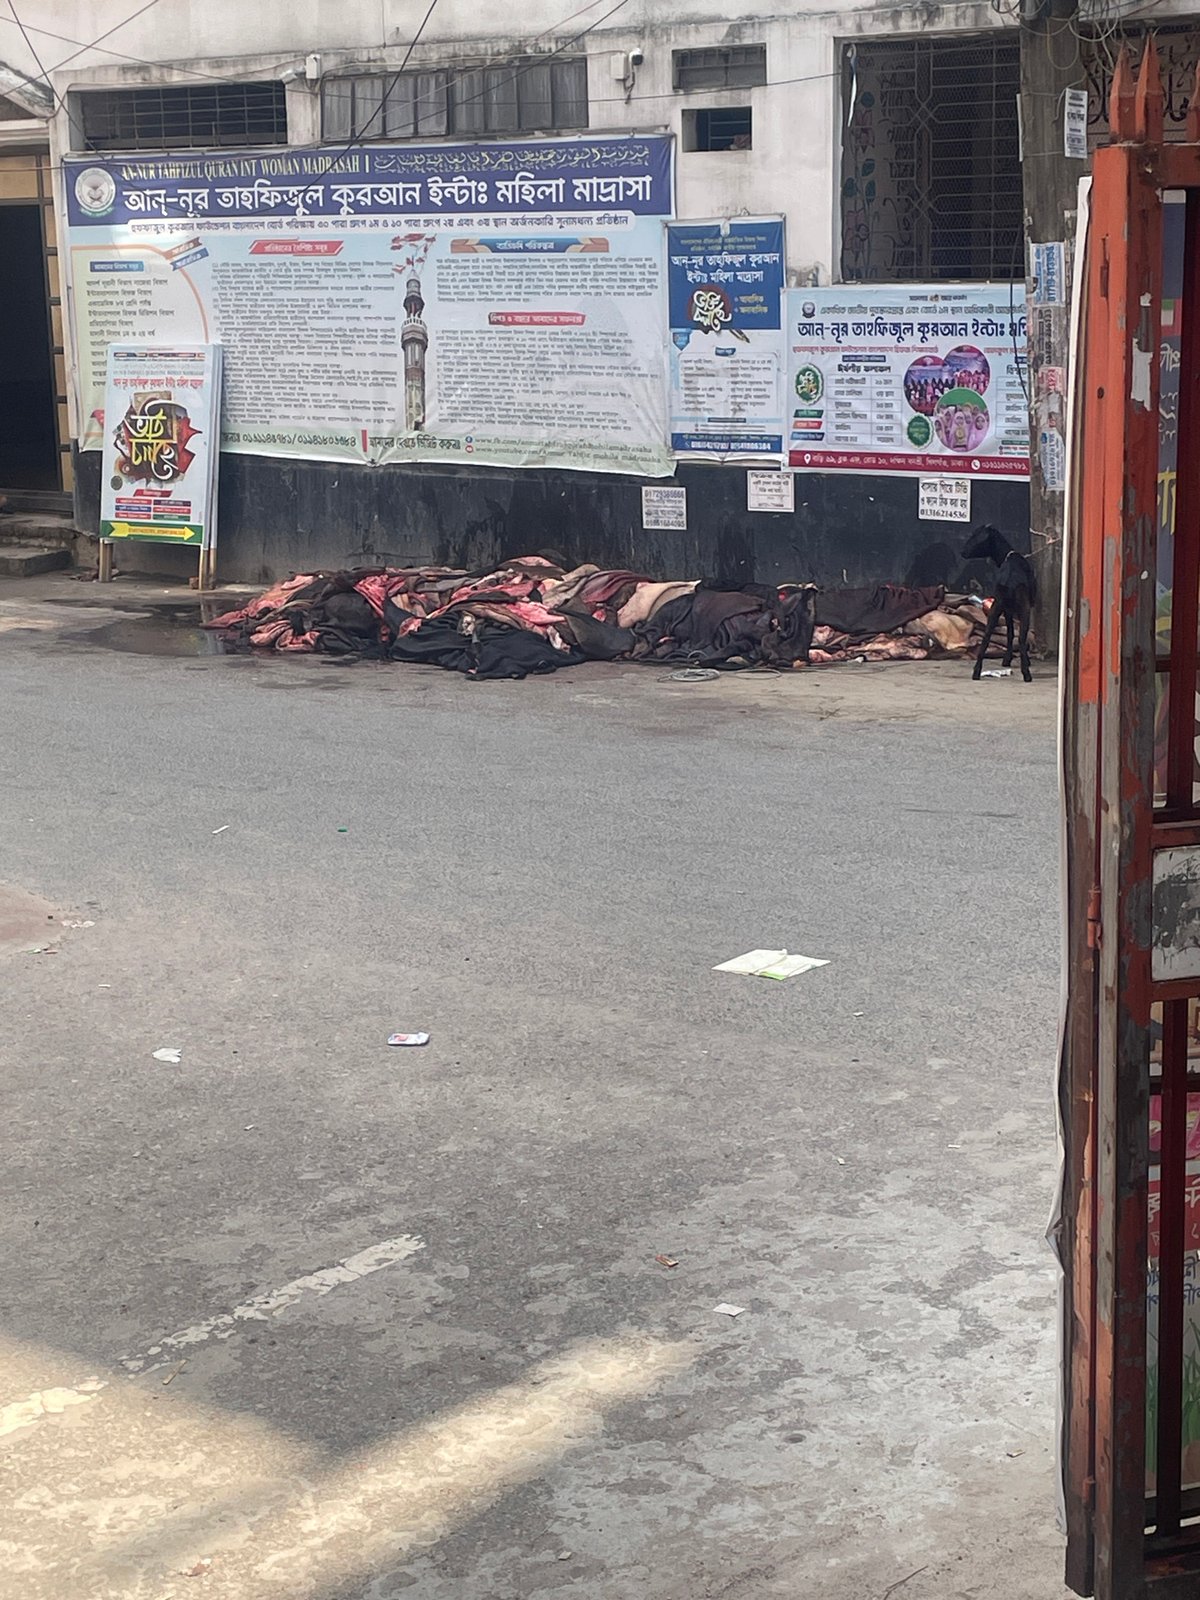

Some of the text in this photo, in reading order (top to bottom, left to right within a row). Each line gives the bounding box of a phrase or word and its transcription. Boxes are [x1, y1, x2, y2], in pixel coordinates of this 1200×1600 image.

[204, 160, 239, 181] QURAN
[260, 156, 300, 177] WOMAN
[302, 154, 360, 175] MADRASAH
[122, 171, 652, 217] আন্-নূর তাহফিজুল কুরআন ইন্টাঃ মহিলা মাদ্রাসা
[852, 316, 914, 344] তাহফিজুল
[917, 320, 969, 344] কুরআন
